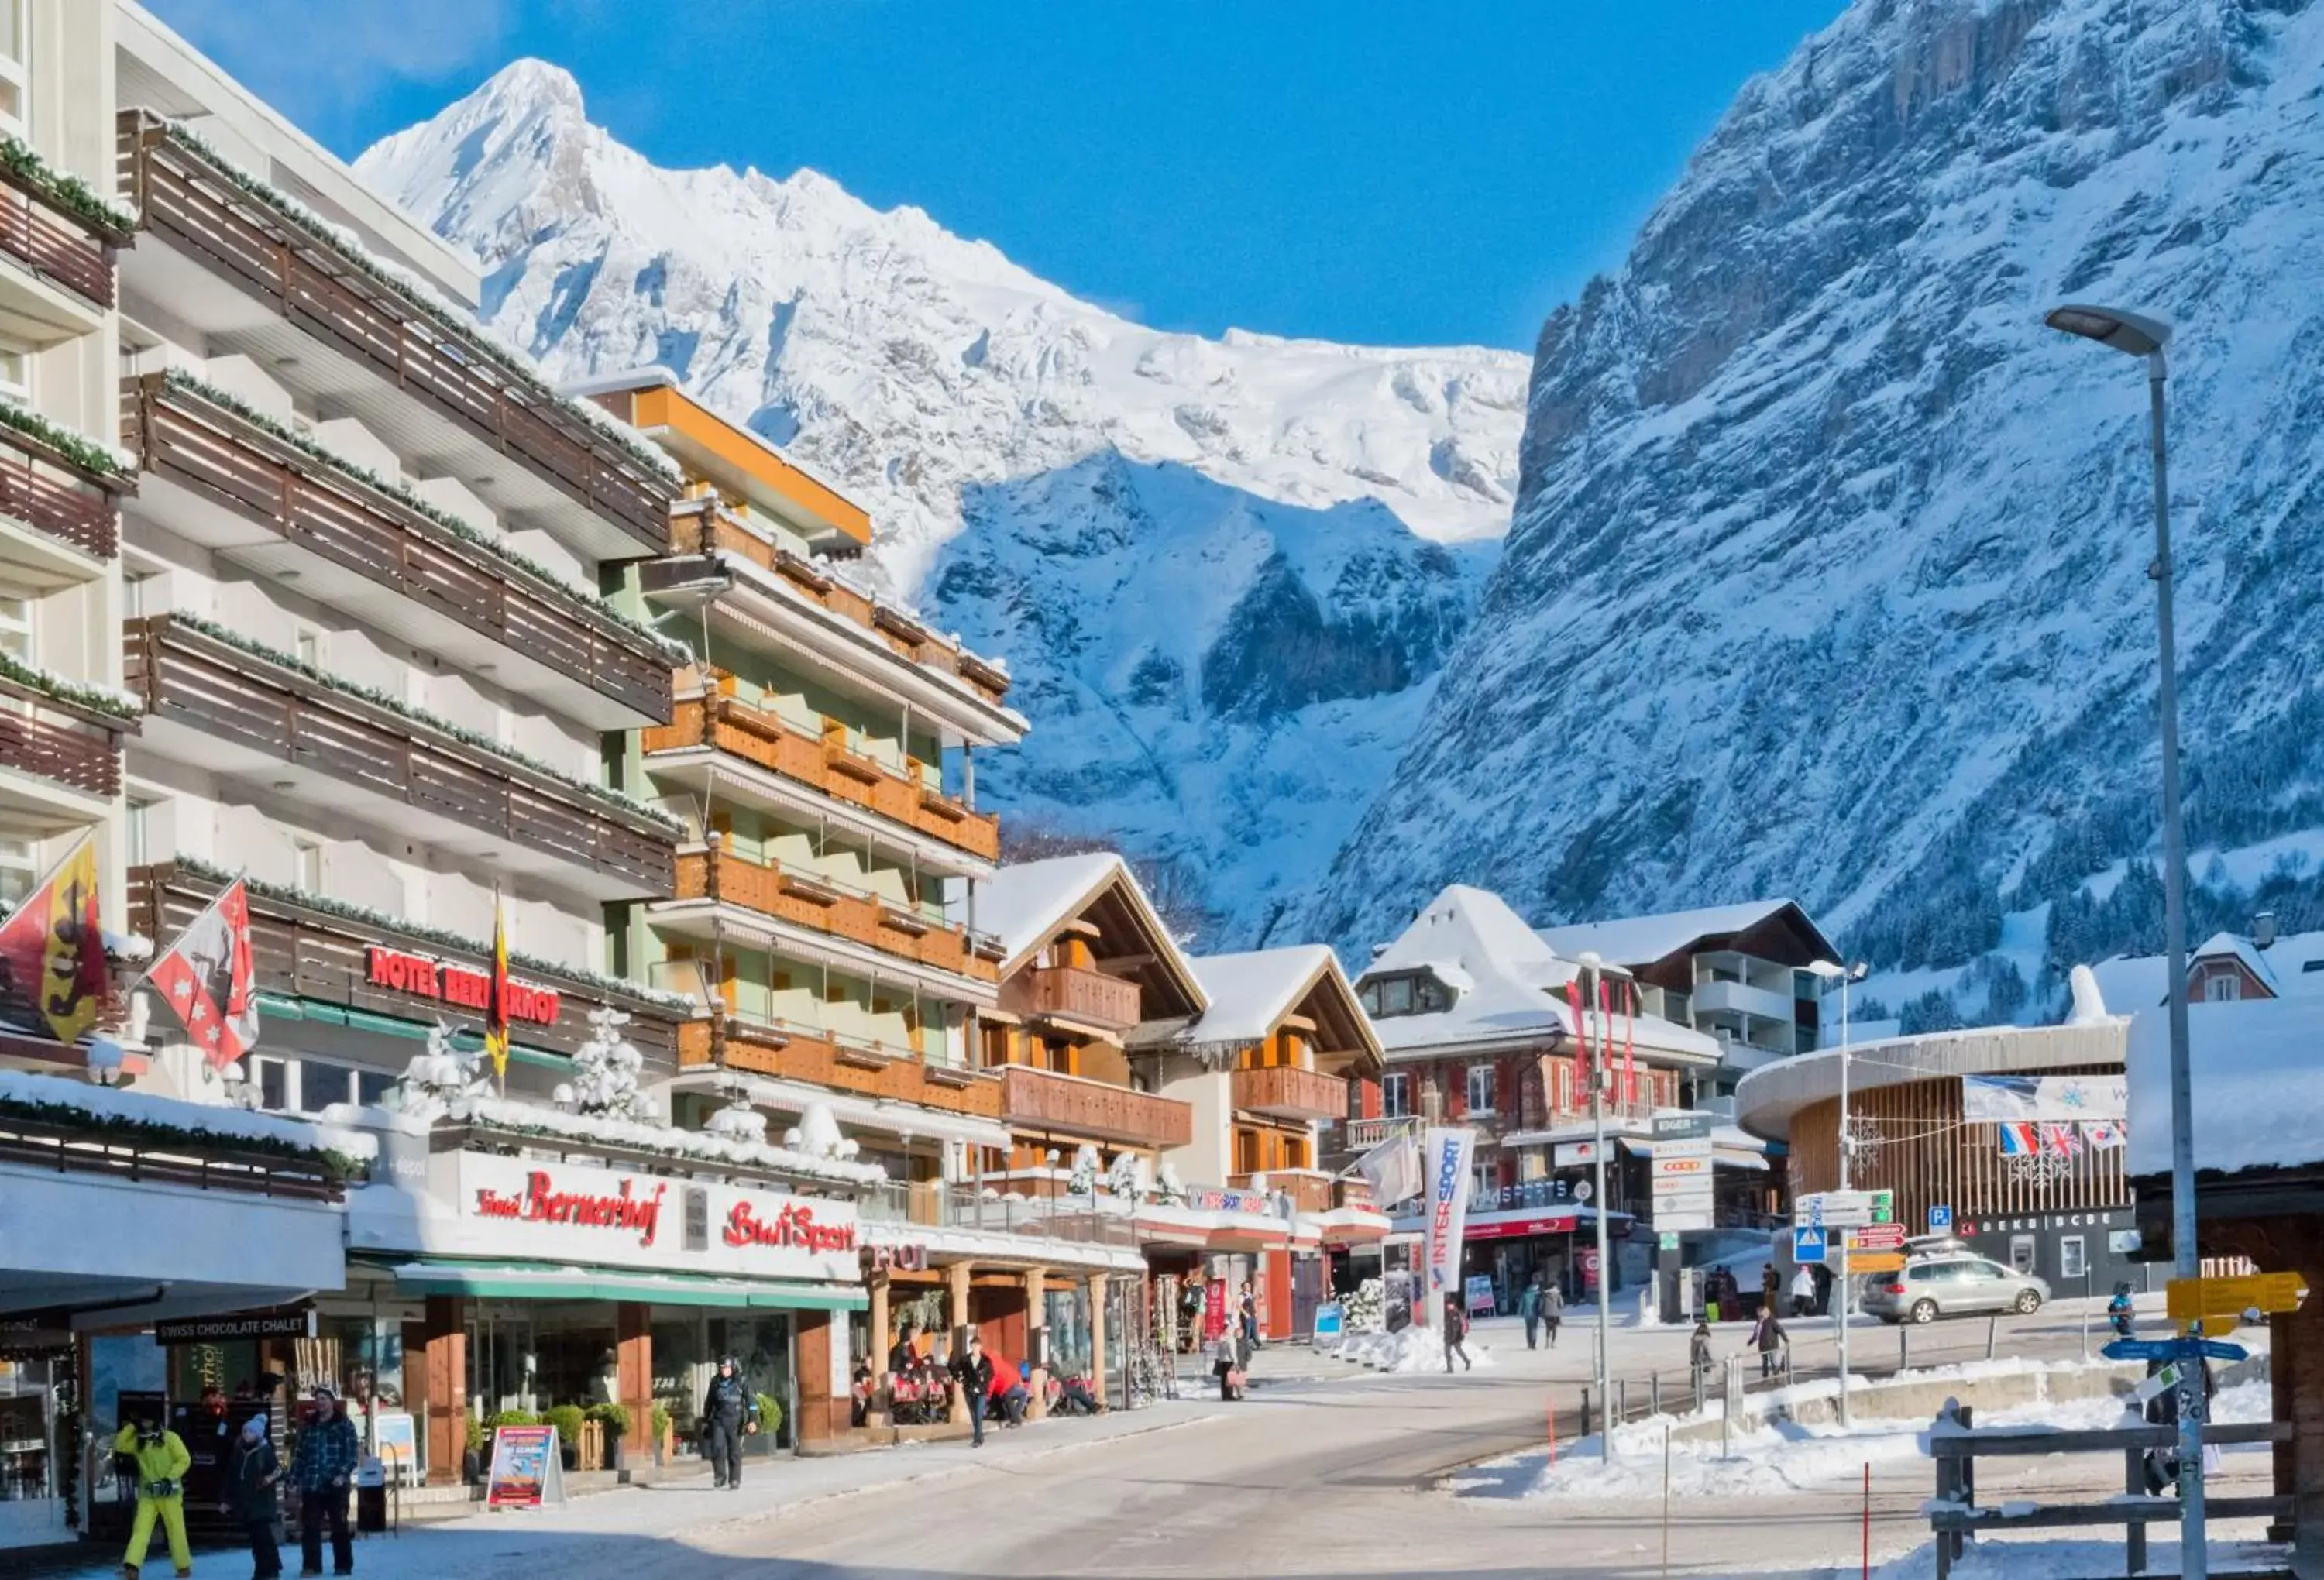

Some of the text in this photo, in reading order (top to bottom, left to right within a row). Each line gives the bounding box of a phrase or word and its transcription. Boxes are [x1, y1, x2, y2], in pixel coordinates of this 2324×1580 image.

[371, 946, 440, 998] HOTEL
[1432, 1137, 1461, 1264] INTERSPORT
[1982, 1212, 2110, 1232] BEKB BCBE
[161, 1317, 303, 1338] SWISS CHOCOLATE CHALET
